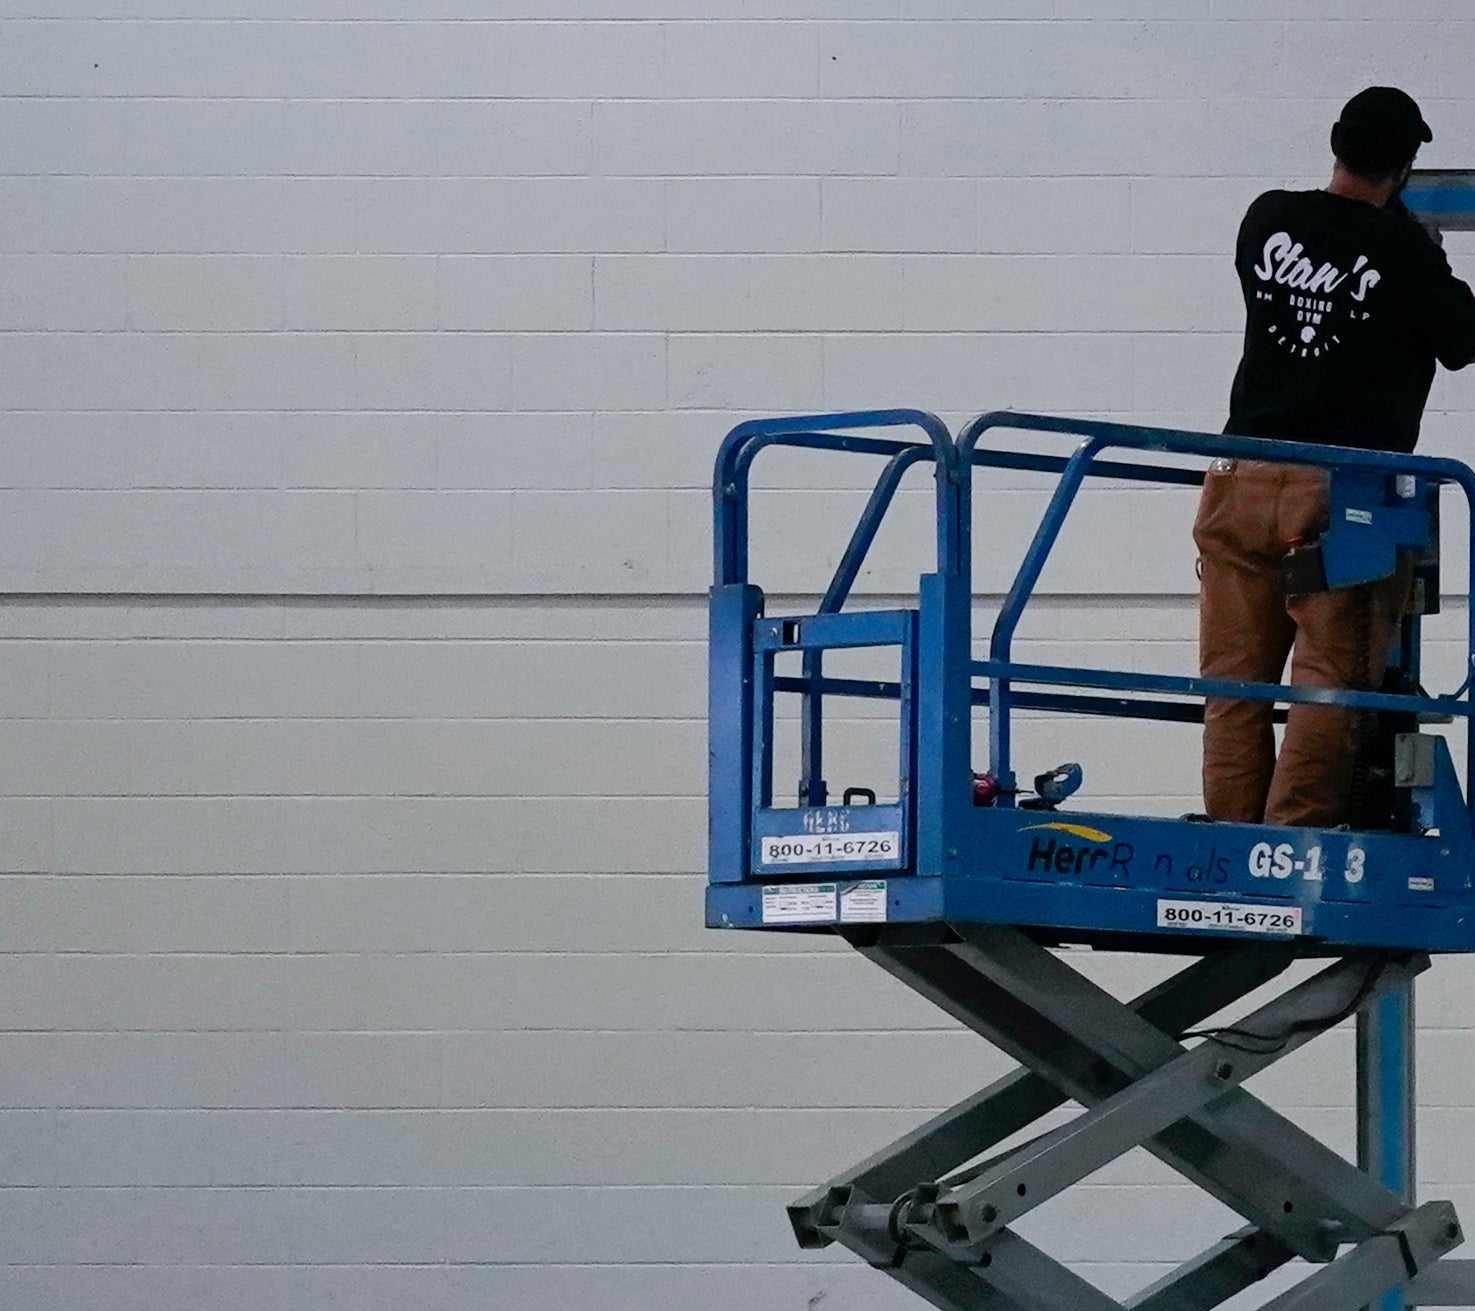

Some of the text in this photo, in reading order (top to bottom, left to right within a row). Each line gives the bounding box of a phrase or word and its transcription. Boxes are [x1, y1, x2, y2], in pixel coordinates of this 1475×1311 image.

[1254, 231, 1381, 301] Stan's
[1289, 294, 1333, 312] BOXING
[1296, 310, 1322, 324] GYM
[769, 840, 892, 859] 800-11-6726
[1165, 908, 1295, 928] 800-11-6726
